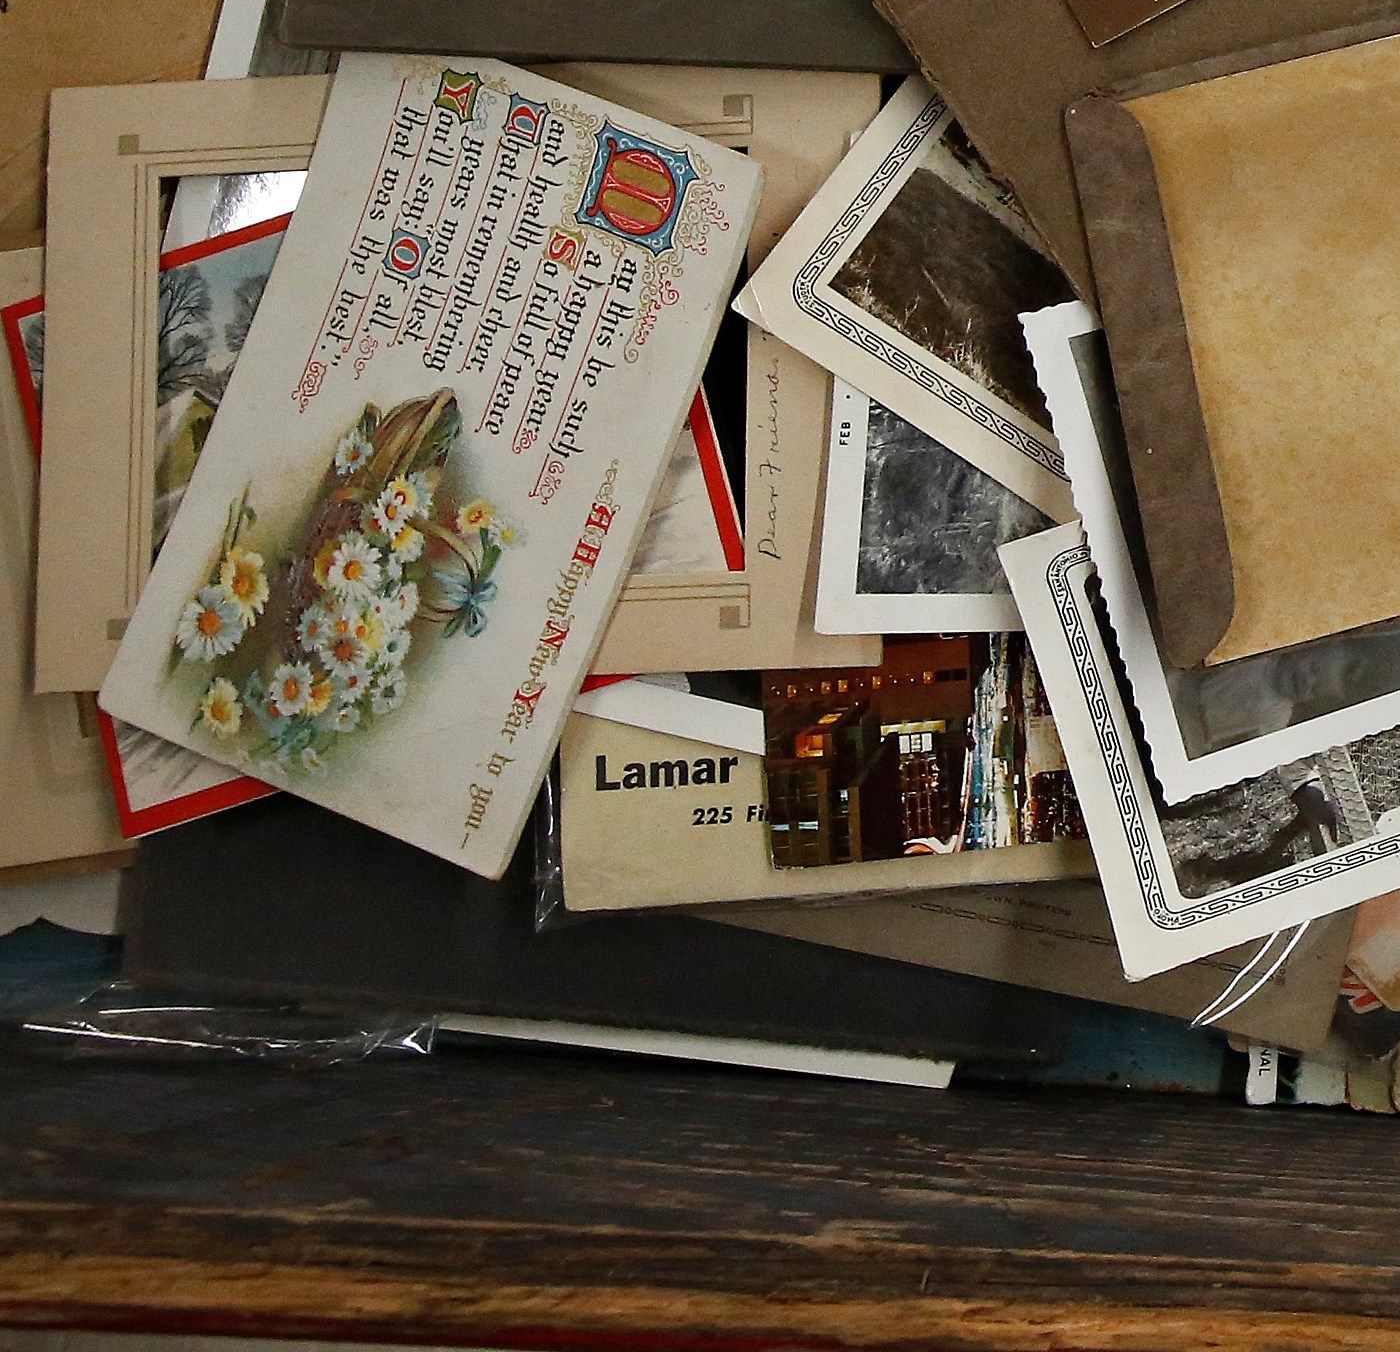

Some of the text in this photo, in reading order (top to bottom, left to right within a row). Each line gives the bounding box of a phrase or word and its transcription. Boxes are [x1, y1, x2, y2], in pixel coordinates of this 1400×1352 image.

[381, 105, 432, 161] that
[368, 166, 401, 222] was
[486, 184, 515, 211] in
[342, 230, 386, 276] the
[396, 134, 485, 357] years most blest,
[462, 118, 570, 374] and health and cheer,
[361, 293, 401, 334] all,
[422, 209, 498, 373] remembering
[477, 229, 581, 436] So full of peace
[518, 249, 606, 432] a happy year
[588, 295, 636, 350] this
[581, 355, 616, 389] be
[549, 392, 589, 460] such
[838, 421, 852, 447] FEB
[584, 502, 614, 534] A
[756, 485, 782, 561] Dear
[546, 536, 599, 619] Happy
[527, 619, 569, 684] New
[499, 681, 544, 746] Year
[486, 752, 516, 778] to
[594, 748, 740, 792] Lamar
[691, 804, 765, 827] 225 Fi
